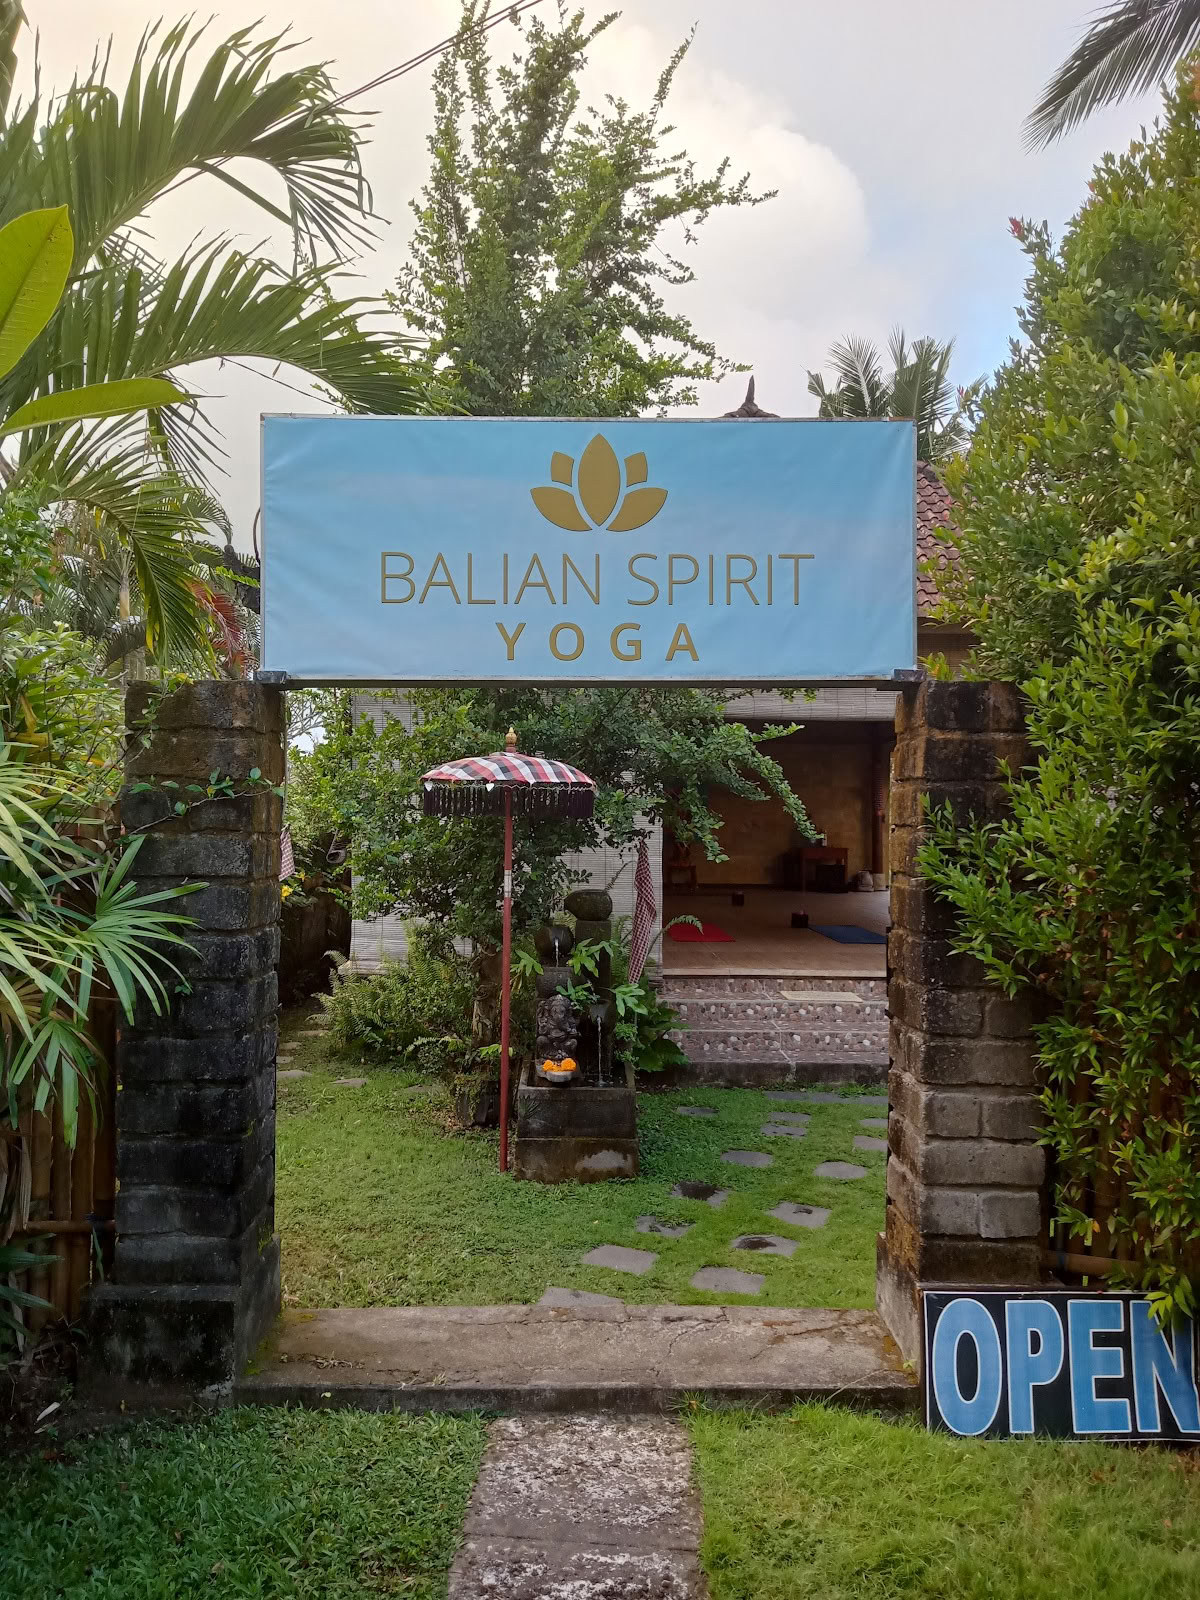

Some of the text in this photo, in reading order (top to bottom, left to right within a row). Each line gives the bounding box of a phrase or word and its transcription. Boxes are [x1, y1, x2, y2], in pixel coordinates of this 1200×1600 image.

[380, 551, 815, 606] BALIAN SPIRIT
[495, 622, 700, 662] YOGA
[932, 1298, 1200, 1436] OPEN
